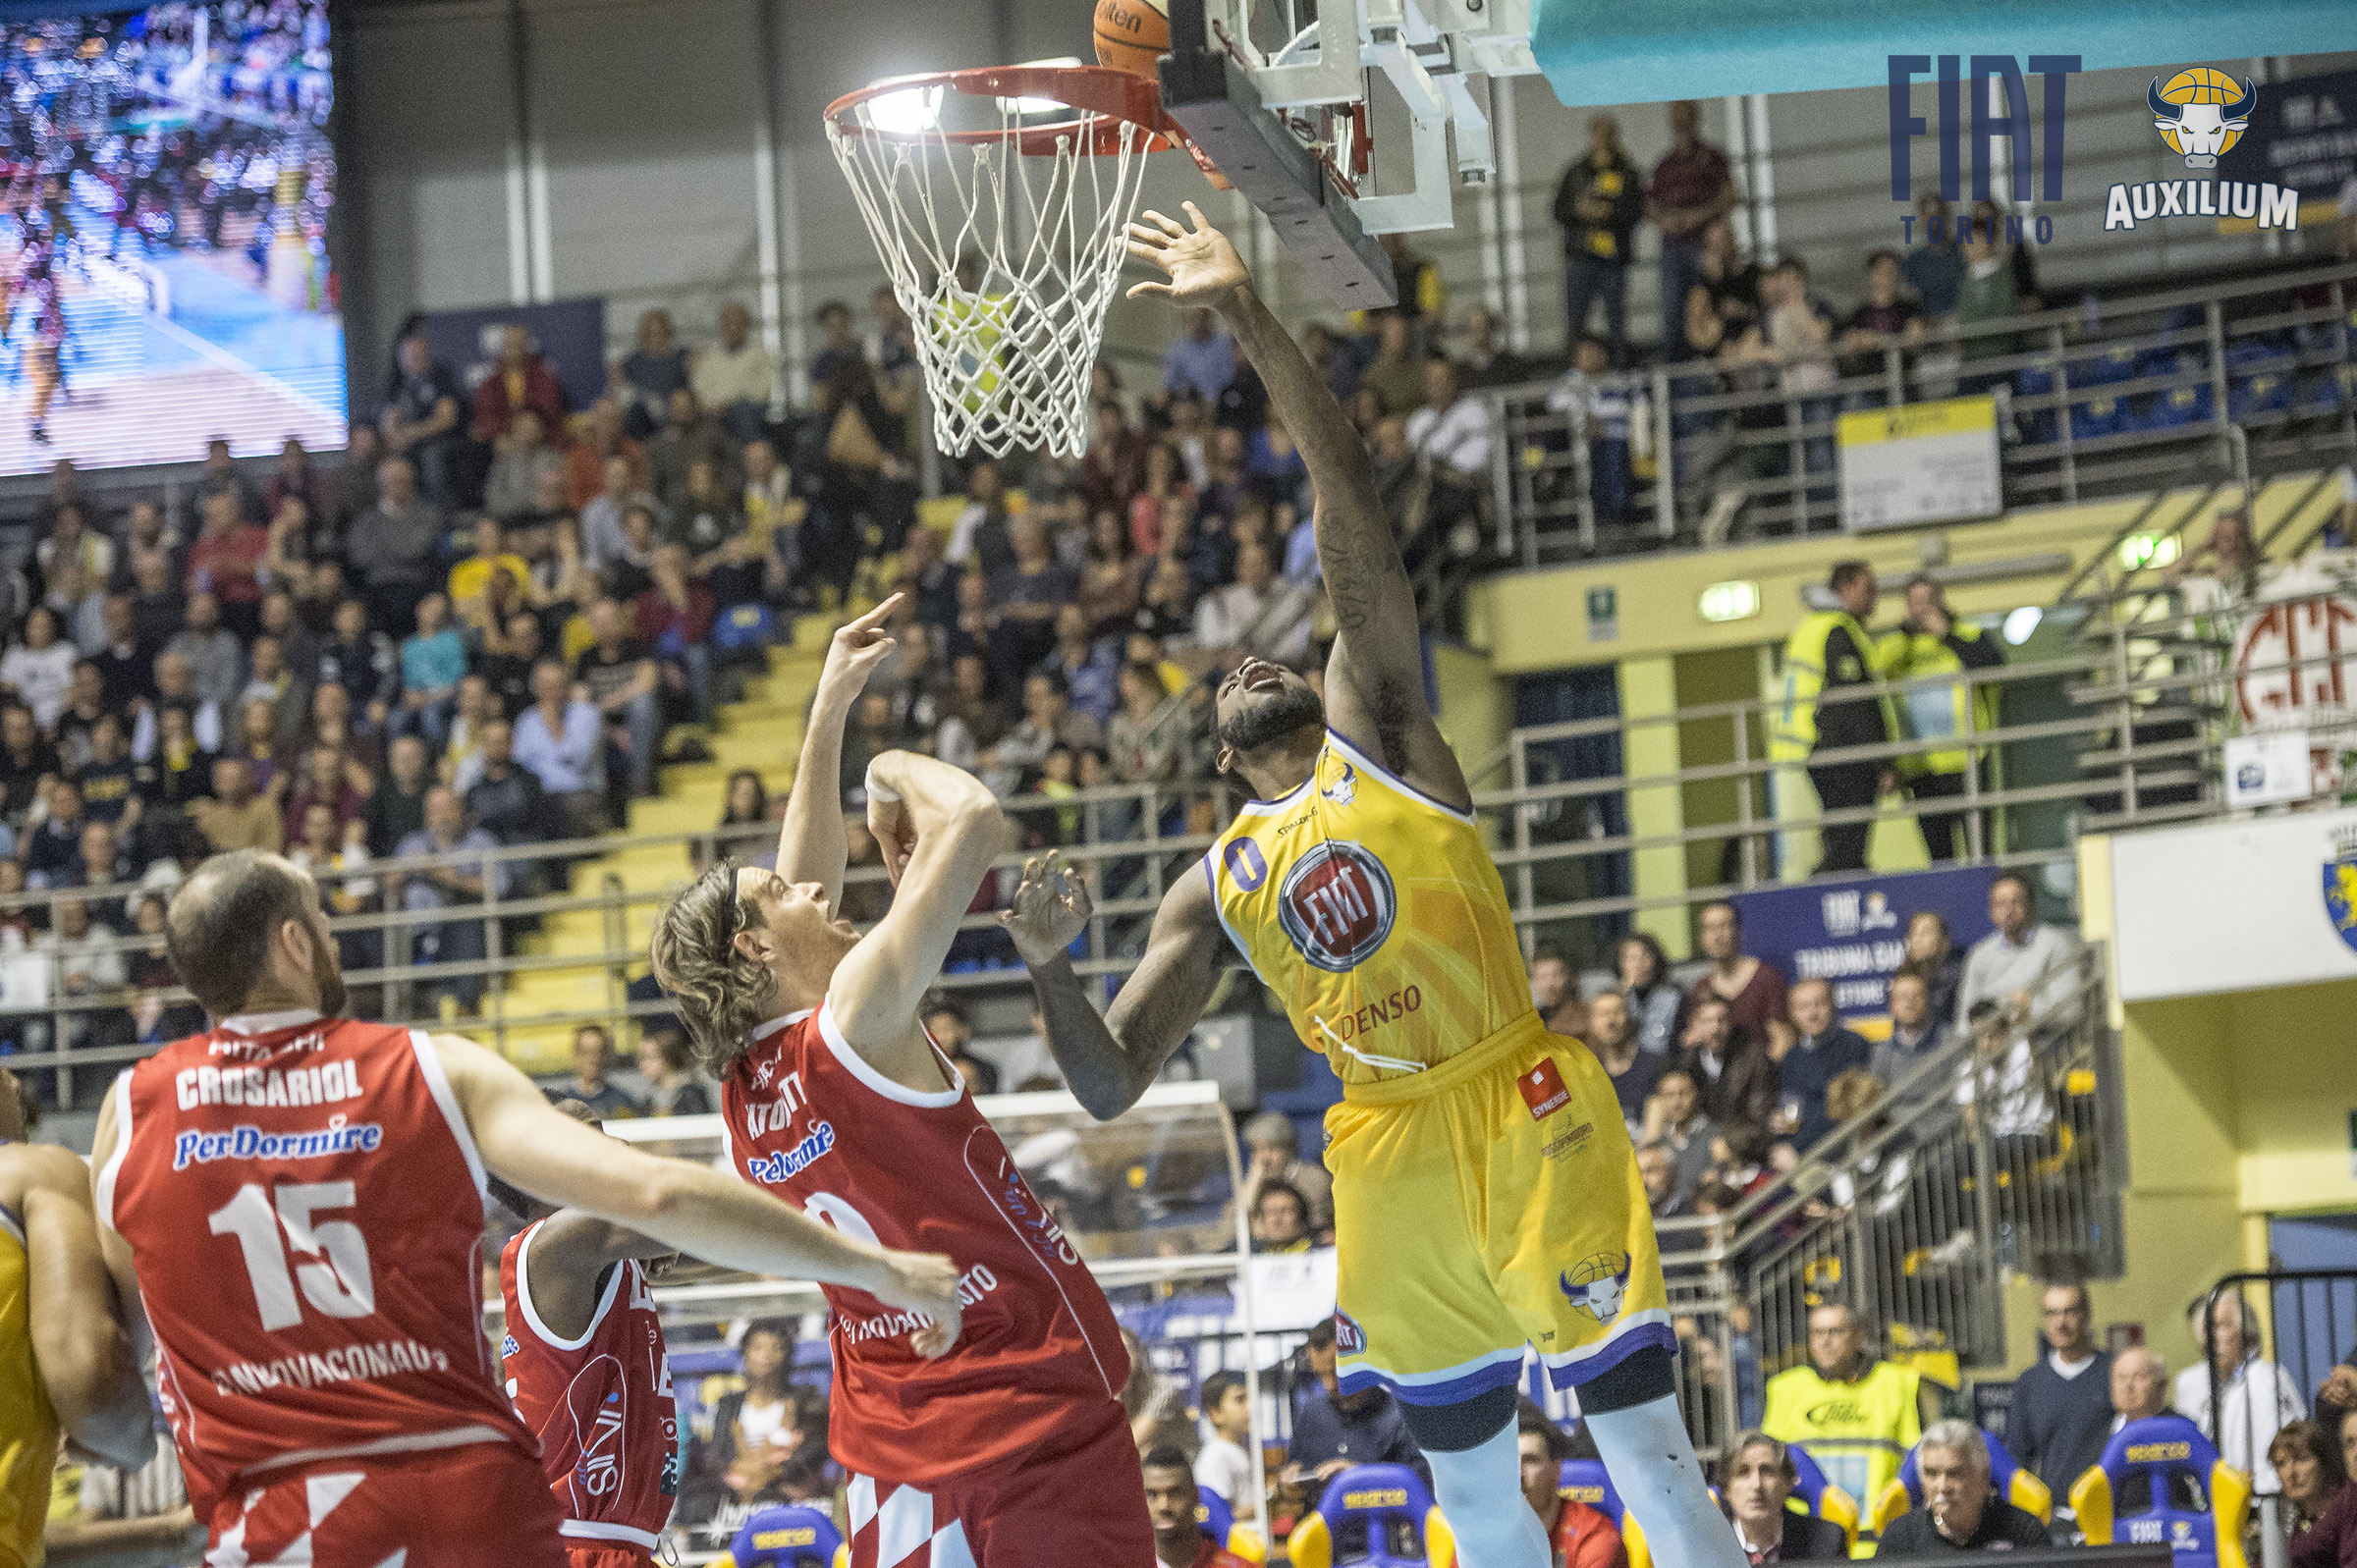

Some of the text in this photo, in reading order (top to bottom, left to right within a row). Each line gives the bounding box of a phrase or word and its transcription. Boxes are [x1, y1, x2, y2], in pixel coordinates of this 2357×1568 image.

[1303, 865, 1369, 946] FIAT
[1342, 985, 1422, 1042] DENSO
[176, 1058, 364, 1111] CROSARIOL
[173, 1113, 383, 1171] PerDormire
[207, 1179, 376, 1332] 15
